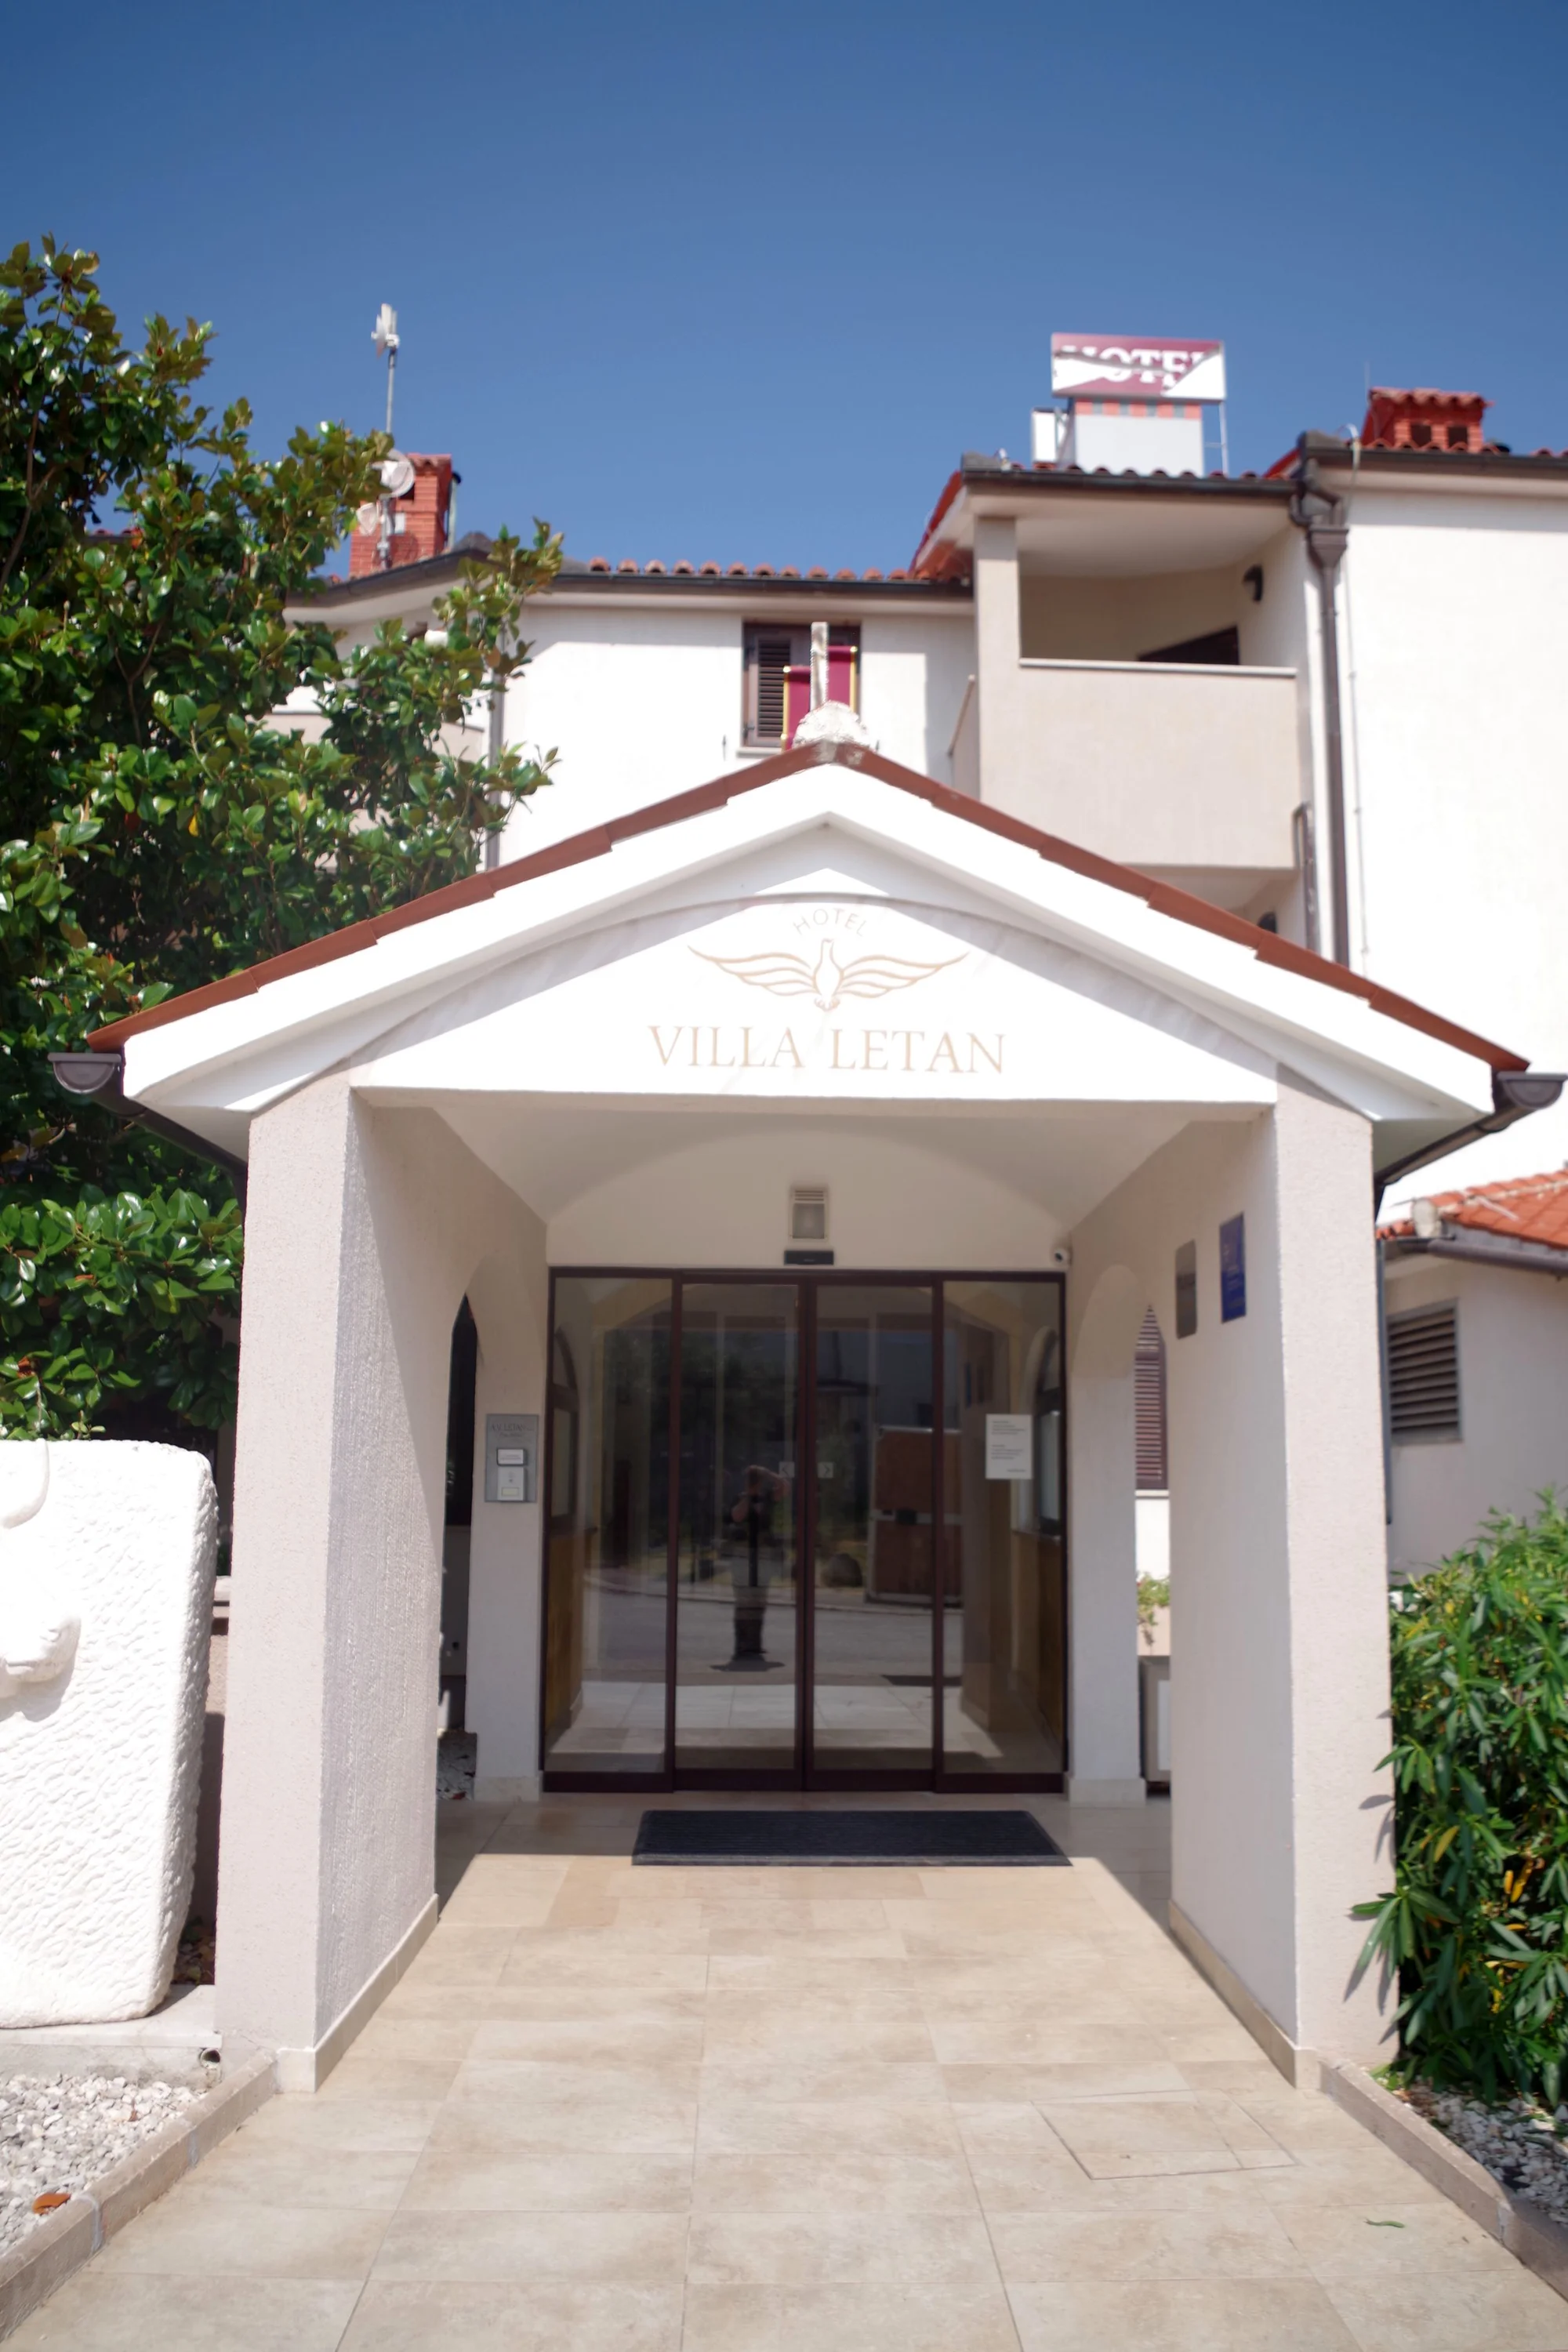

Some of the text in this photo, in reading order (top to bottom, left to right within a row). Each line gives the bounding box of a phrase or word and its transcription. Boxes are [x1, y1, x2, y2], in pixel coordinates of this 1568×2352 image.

[793, 908, 866, 936] HOTEL
[648, 1025, 1007, 1074] VILLA LETAN
